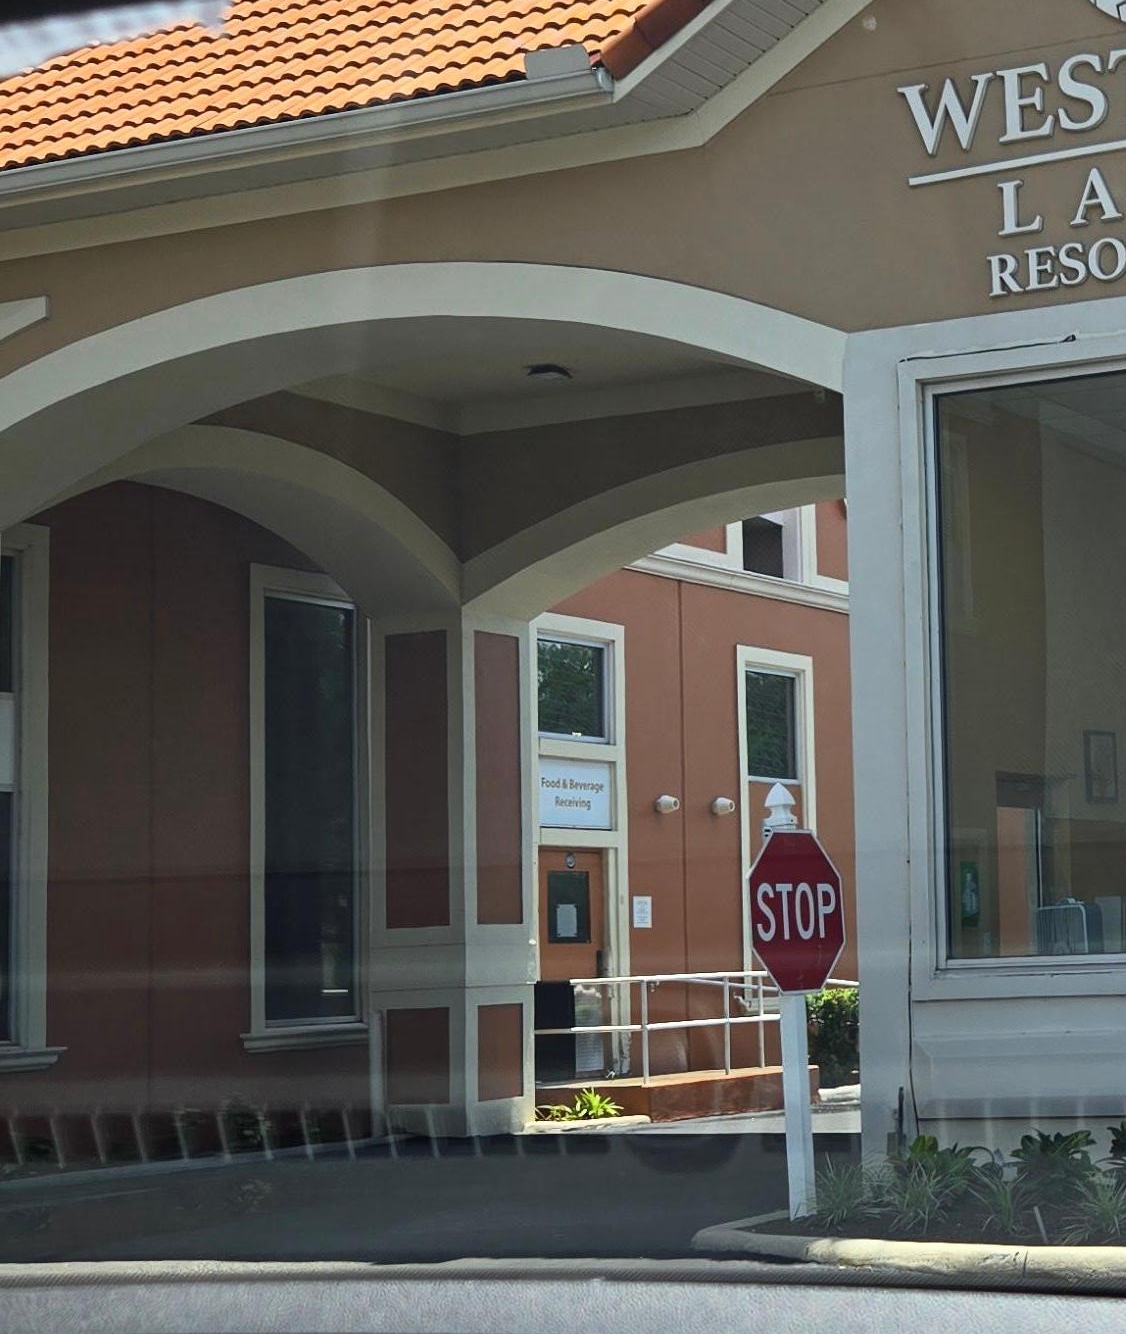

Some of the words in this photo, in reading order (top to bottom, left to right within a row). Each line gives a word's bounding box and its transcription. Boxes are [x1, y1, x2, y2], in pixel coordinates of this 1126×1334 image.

[541, 777, 560, 788] Food
[562, 778, 568, 789] &
[569, 779, 604, 794] Beverage
[555, 795, 591, 811] Receiving
[756, 882, 838, 942] STOP
